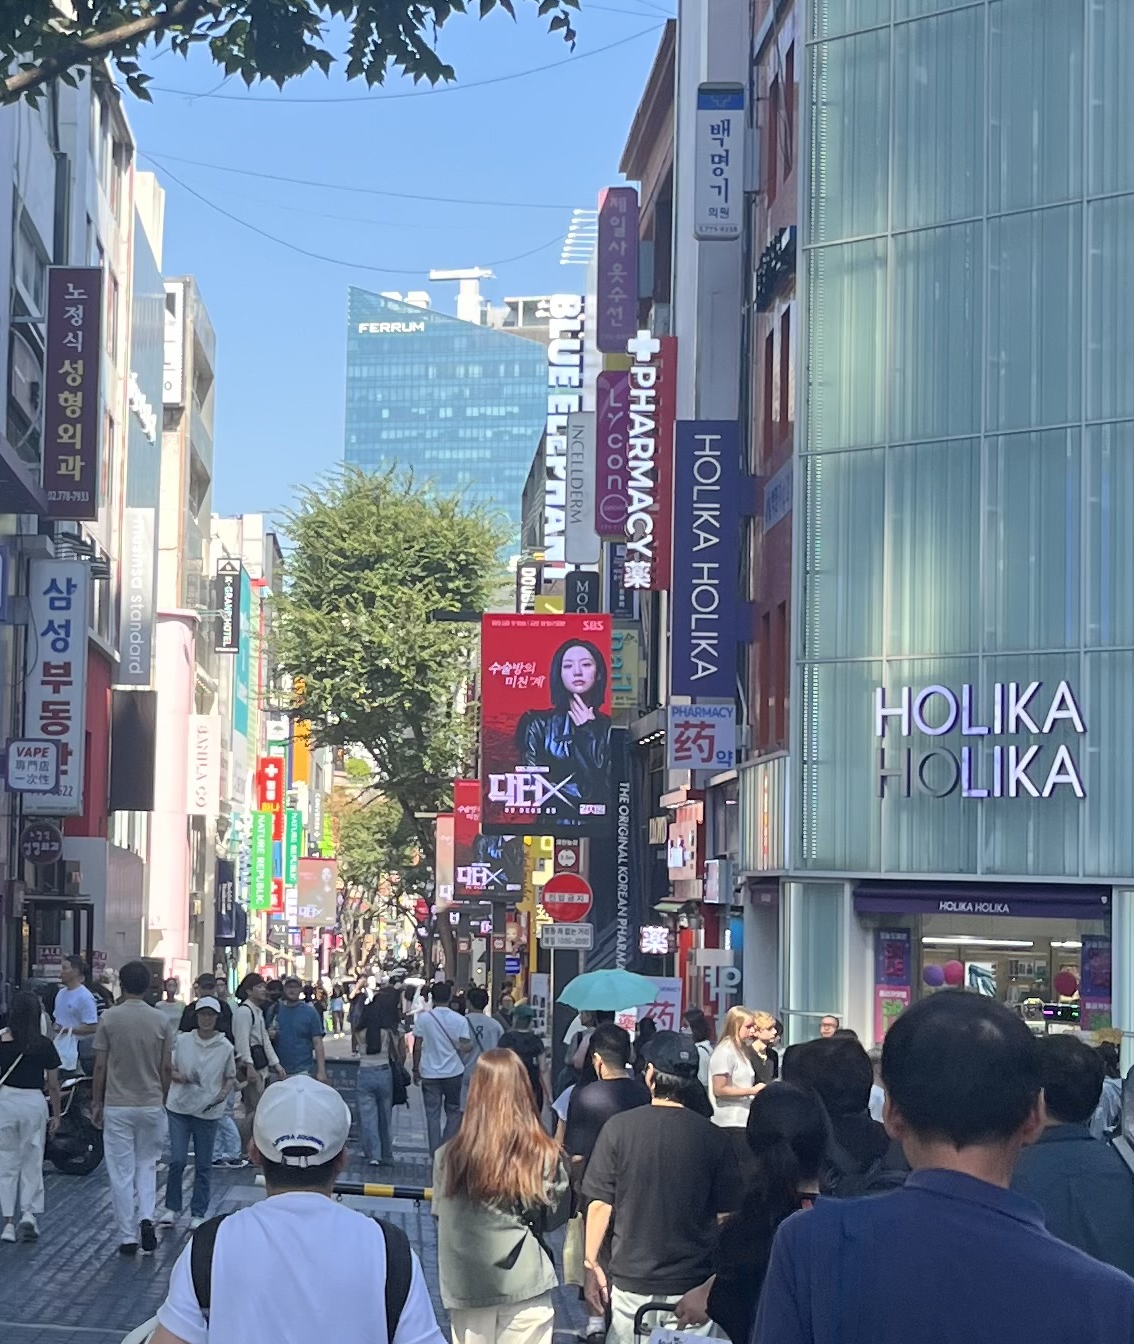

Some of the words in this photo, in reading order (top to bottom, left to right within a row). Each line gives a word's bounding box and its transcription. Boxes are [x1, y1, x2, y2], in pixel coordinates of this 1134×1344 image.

[708, 118, 731, 204] 백명기
[707, 207, 730, 219] 의원
[61, 282, 88, 353] 노정식
[606, 262, 628, 327] 옷수선
[358, 321, 425, 333] FERRUM
[547, 293, 583, 389] BLUE
[56, 359, 86, 482] 성형외과
[570, 424, 585, 524] INCELLDERM
[626, 366, 656, 557] PHARMACY
[691, 434, 723, 552] HOLIKA
[128, 595, 144, 674] standard
[222, 618, 233, 647] HOTEL
[582, 620, 605, 631] SBS
[689, 562, 720, 681] HOLIKA
[671, 706, 734, 720] PHARMACY
[875, 680, 1087, 737] HOLIKA
[16, 746, 50, 758] VAPE
[673, 719, 716, 763] 药
[716, 749, 733, 767] 약
[14, 774, 50, 785] 一次性
[618, 782, 630, 804] THE
[875, 744, 1087, 799] HOLIKA
[256, 814, 266, 854] NATURE
[617, 805, 630, 864] ORIGINAL
[255, 856, 265, 905] REPUBLIC
[617, 866, 629, 917] KOREAN
[939, 901, 973, 912] HOLIKA
[975, 902, 1010, 913] HOLIKA
